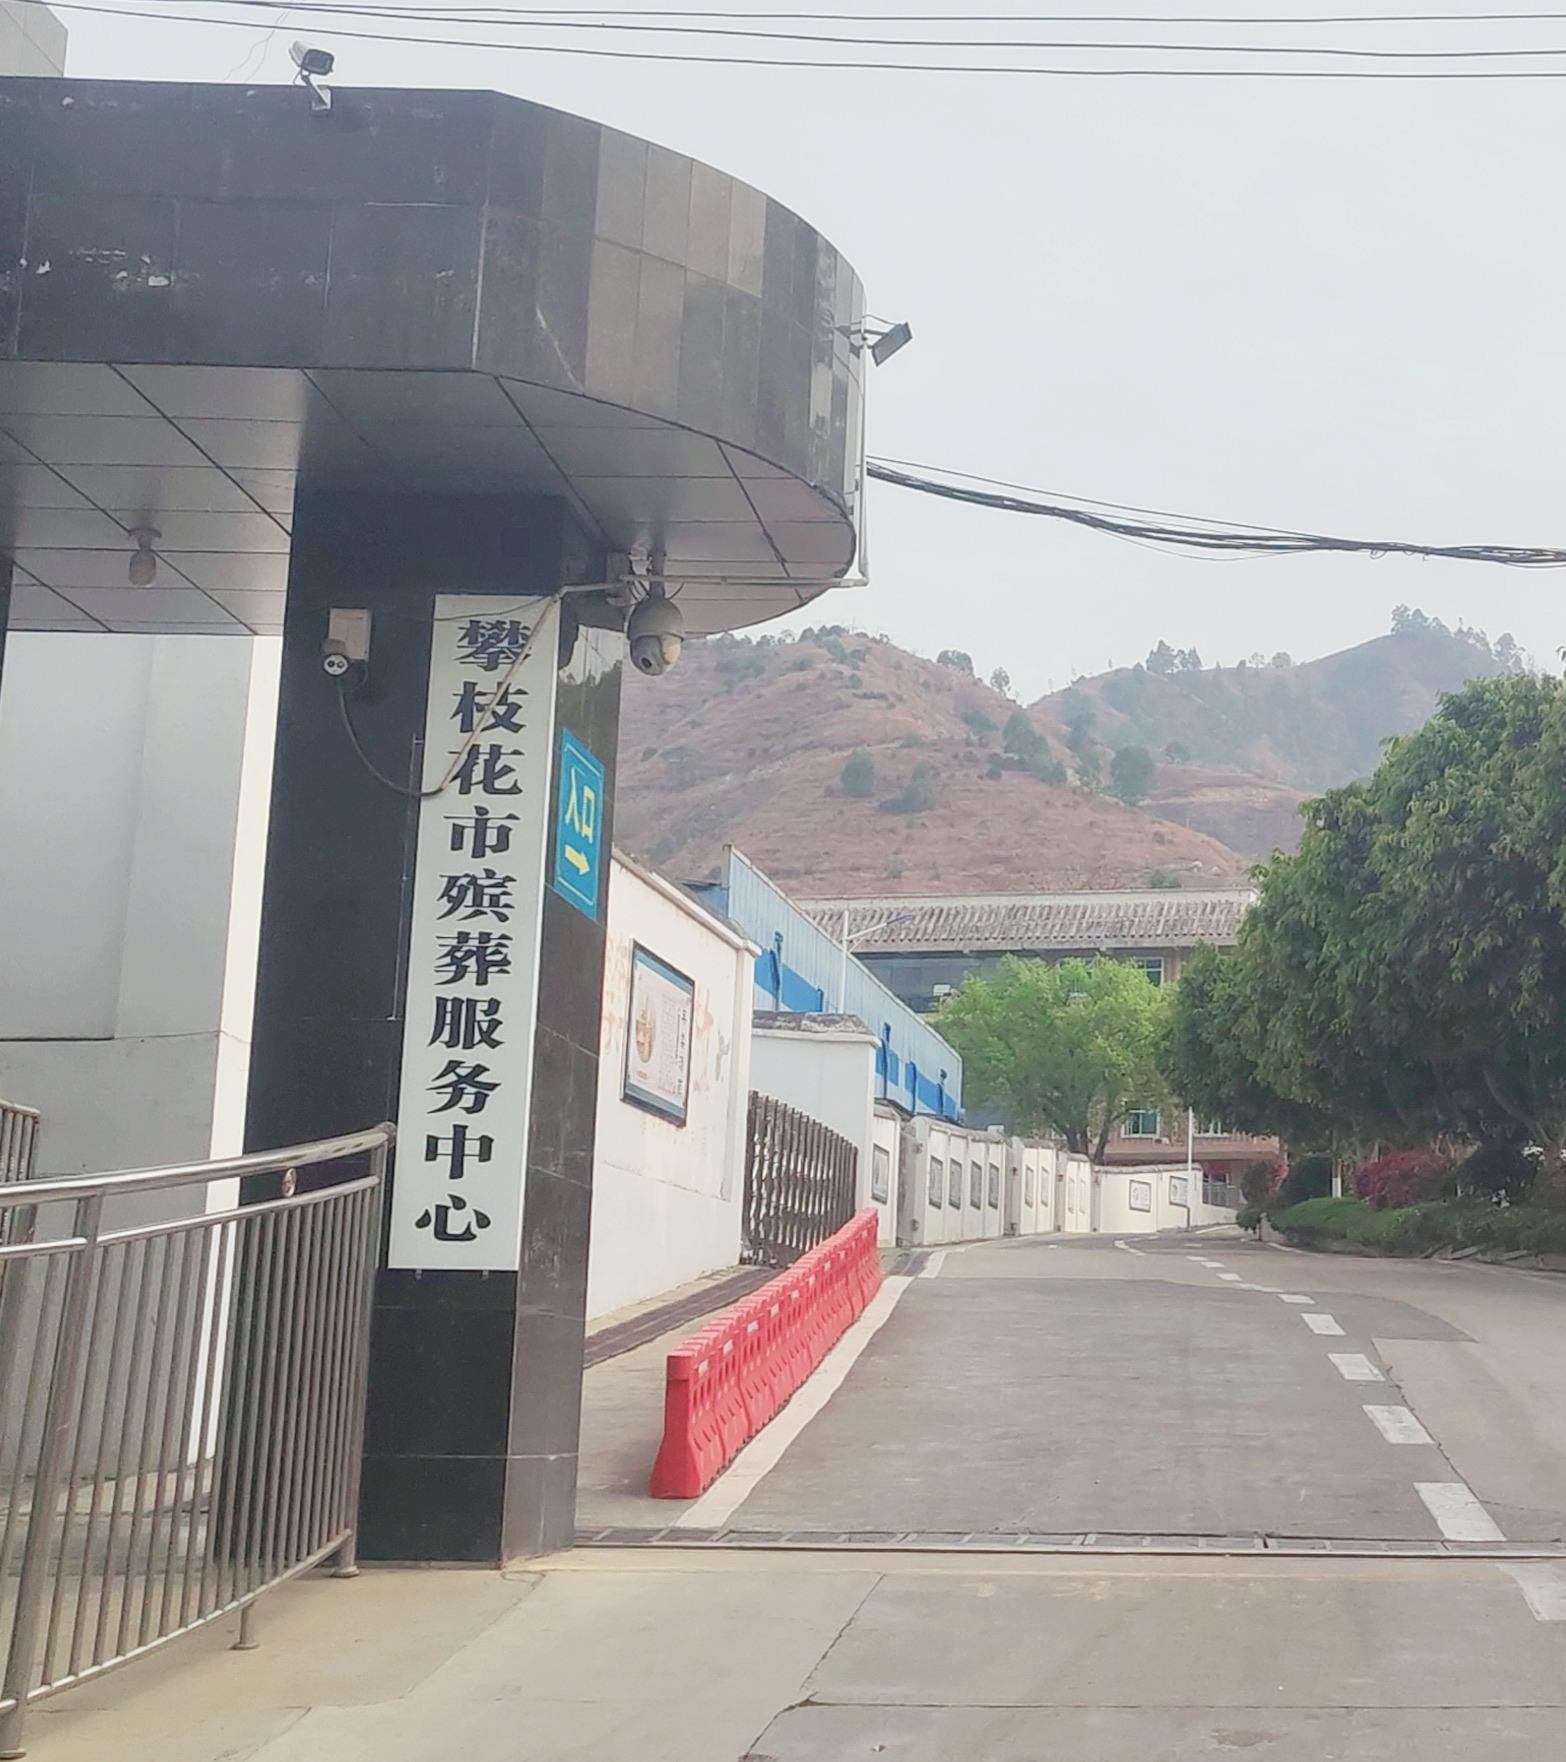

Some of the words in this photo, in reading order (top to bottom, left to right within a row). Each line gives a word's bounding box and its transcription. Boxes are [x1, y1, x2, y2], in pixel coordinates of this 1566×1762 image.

[415, 619, 533, 1243] 攀枝花市殡葬服务中心
[564, 765, 595, 844] 入口
